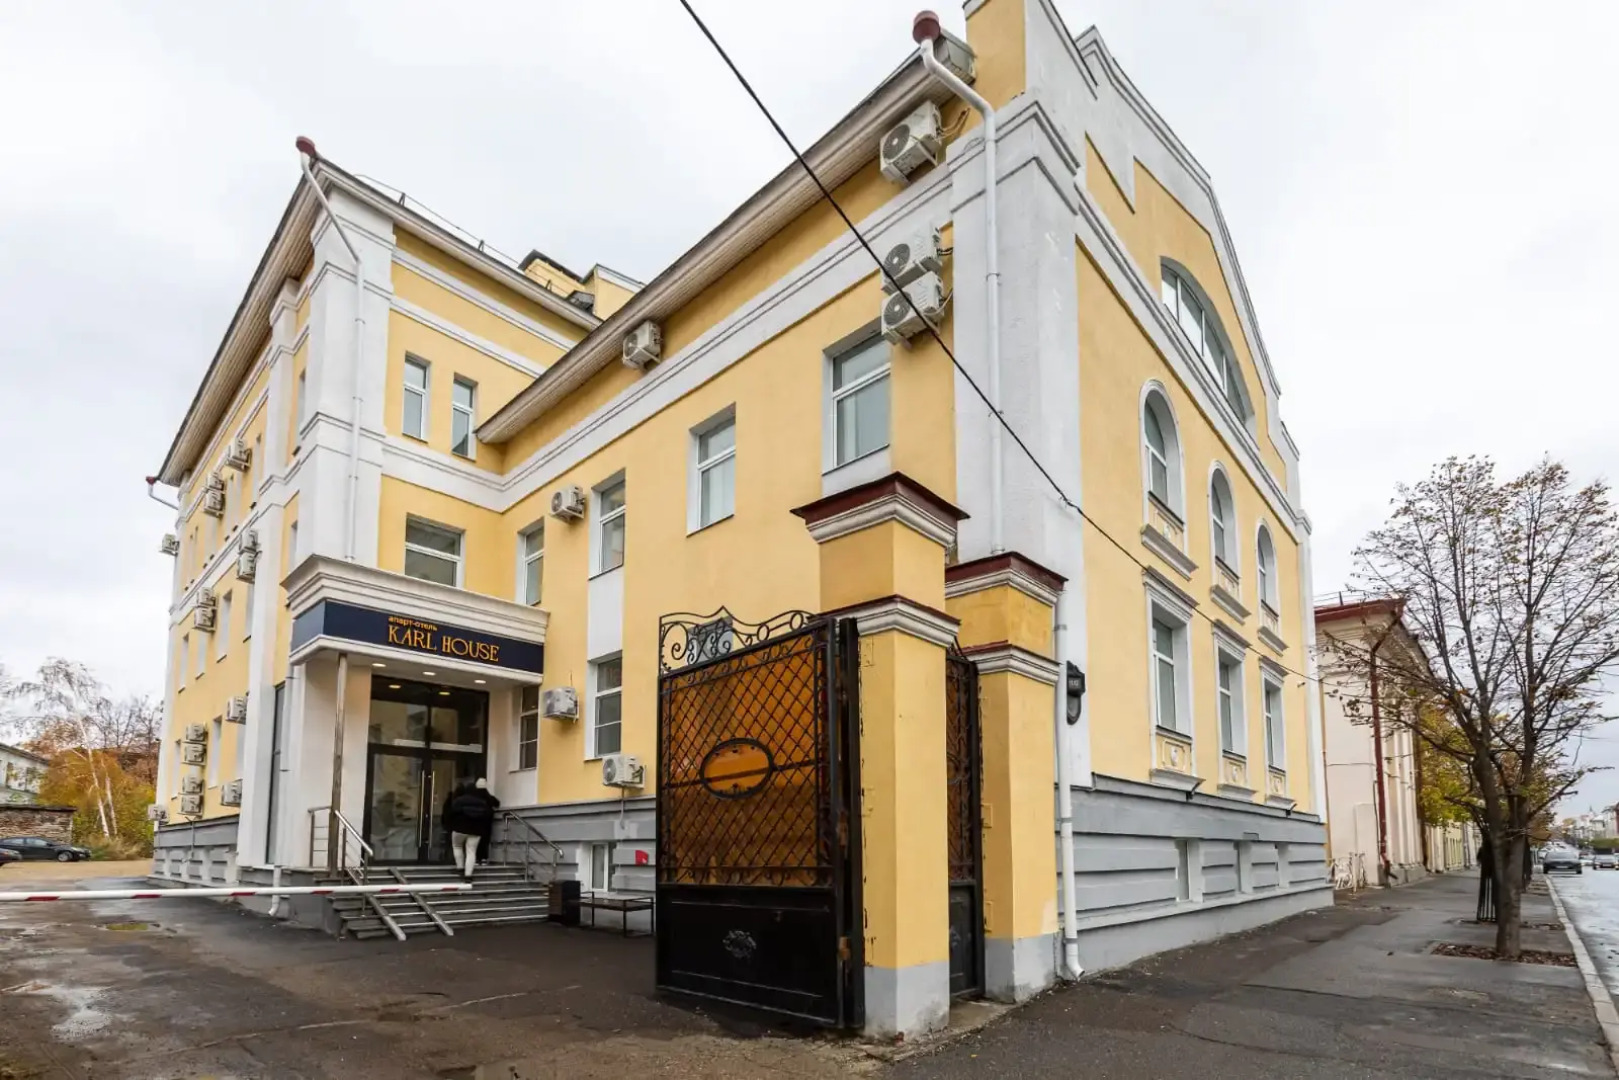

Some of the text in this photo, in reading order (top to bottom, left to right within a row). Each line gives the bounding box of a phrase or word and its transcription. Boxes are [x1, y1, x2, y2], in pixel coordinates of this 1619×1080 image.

[388, 616, 437, 631] апарт-отель
[388, 625, 500, 662] KARL HOUSE
